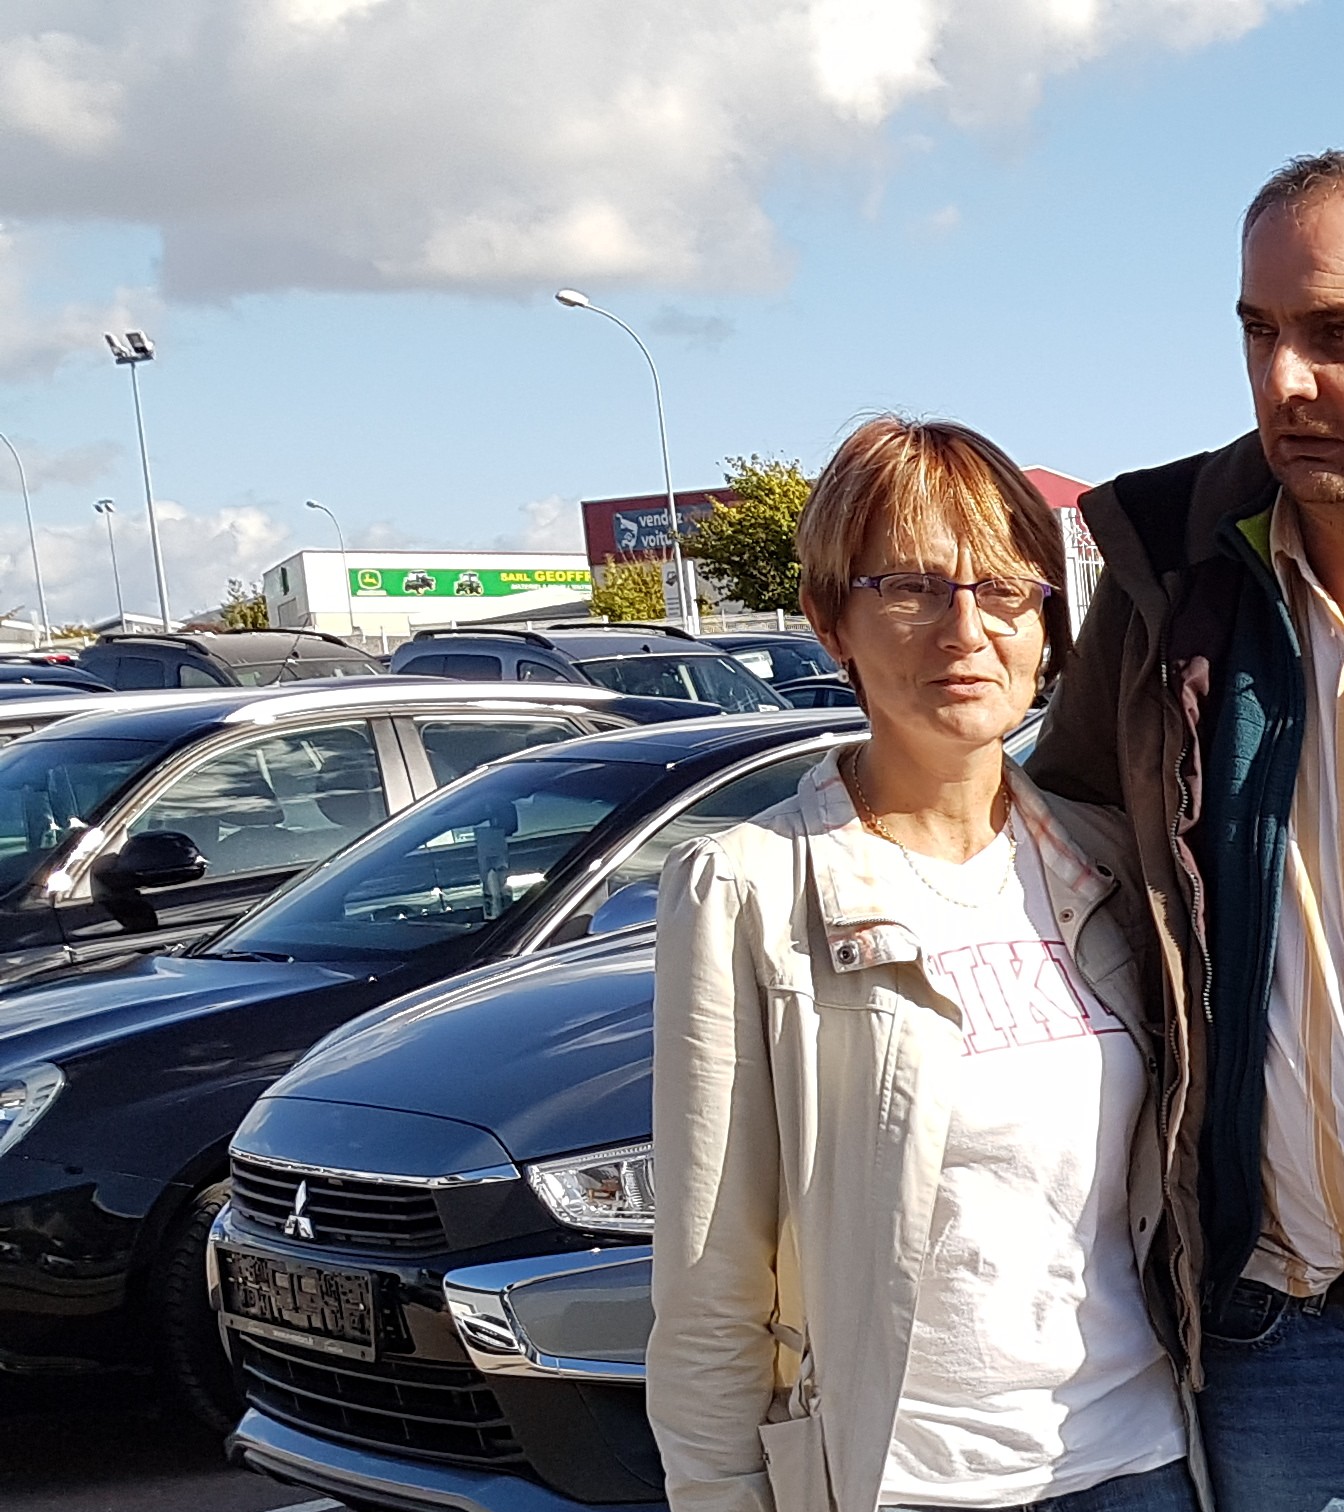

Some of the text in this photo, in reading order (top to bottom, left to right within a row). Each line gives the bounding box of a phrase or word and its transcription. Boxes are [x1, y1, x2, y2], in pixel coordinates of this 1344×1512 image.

[639, 508, 683, 527] vendz
[500, 572, 531, 582] SARL
[927, 940, 1130, 1057] IK
